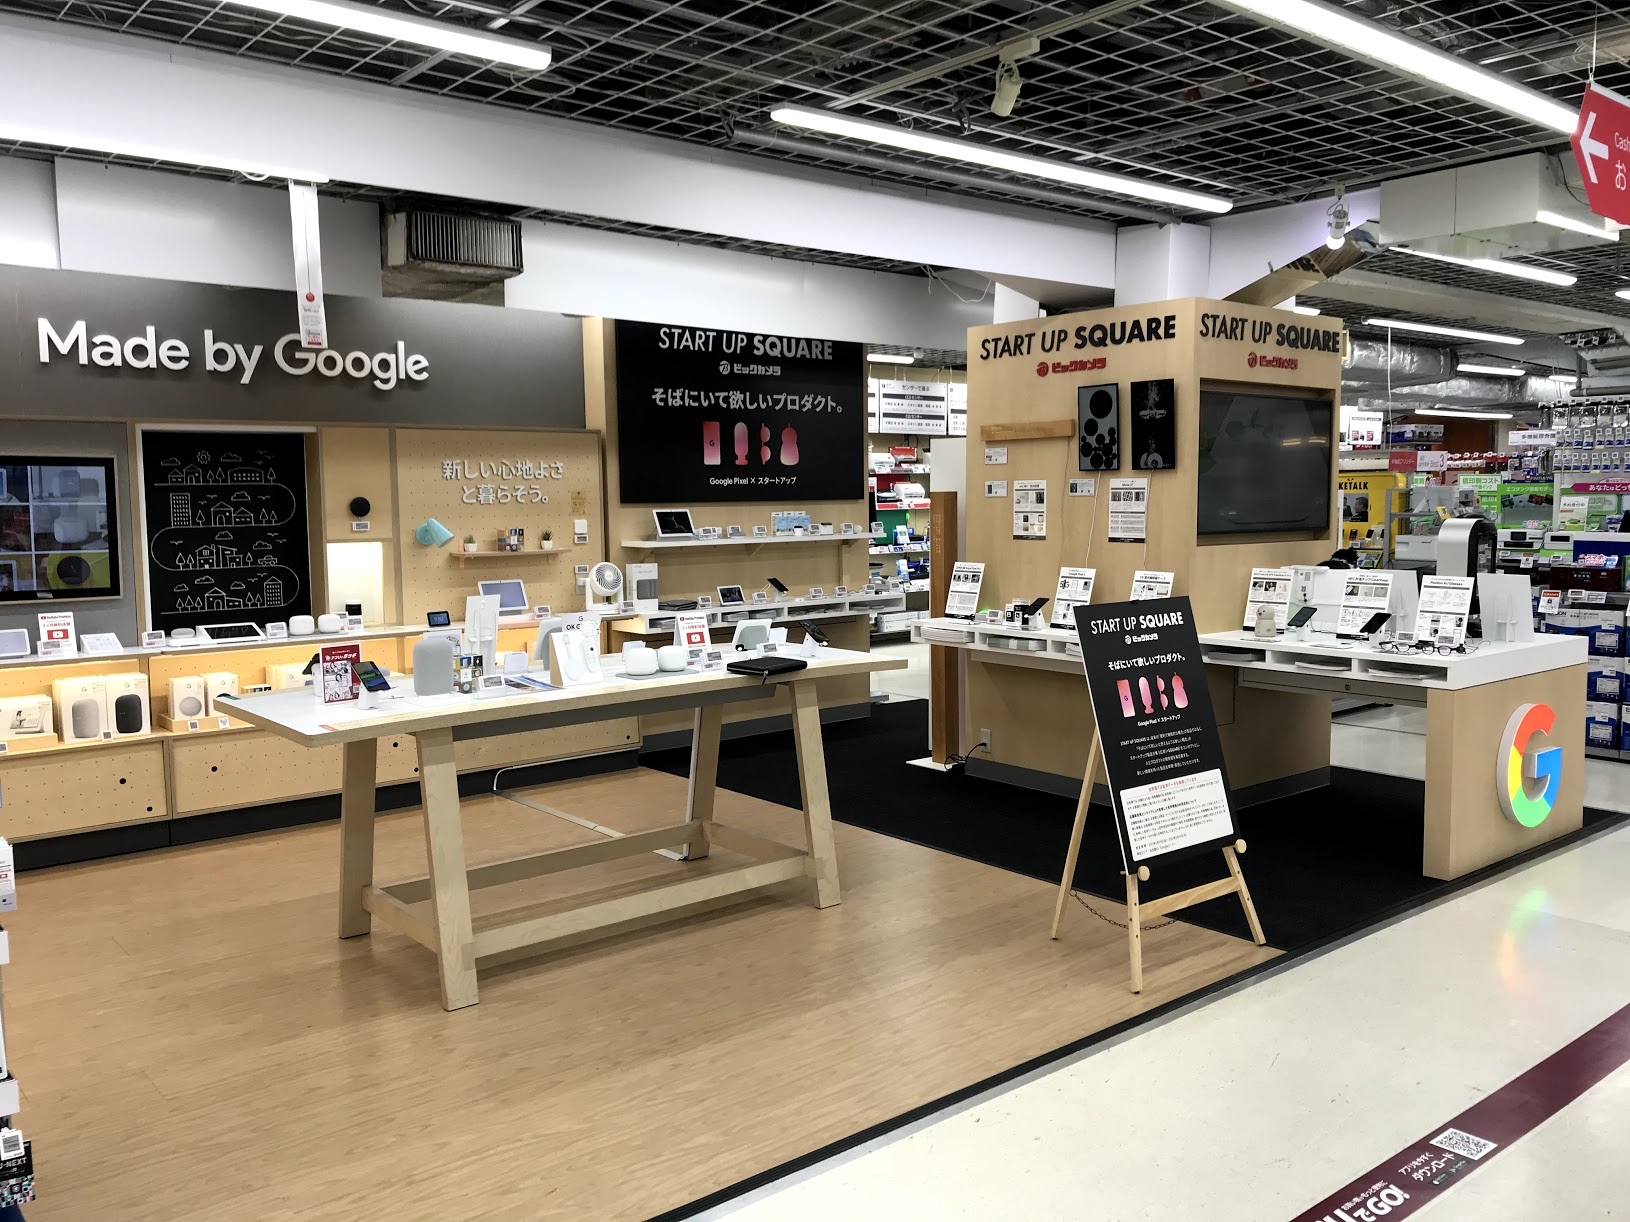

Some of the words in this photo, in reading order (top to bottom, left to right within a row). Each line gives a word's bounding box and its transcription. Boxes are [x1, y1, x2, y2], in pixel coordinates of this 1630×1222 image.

[658, 326, 717, 352] START
[722, 331, 748, 354] UP
[752, 333, 833, 361] SQUARE
[979, 332, 1036, 361] START
[1041, 328, 1068, 353] UP
[1073, 314, 1177, 350] SQUARE
[1200, 312, 1249, 342] START
[1251, 319, 1273, 344] UP
[1275, 322, 1340, 353] SQUARE
[37, 317, 191, 371] Made
[204, 328, 264, 385] by
[273, 332, 430, 391] Google
[1051, 356, 1107, 375] ビックカメラ
[1259, 355, 1299, 370] ビックカメラ
[733, 362, 782, 376] ビックカメラ
[651, 387, 843, 414] そばにいて欲しいプロダクト。
[442, 459, 564, 480] 新しい心地よさ
[709, 477, 733, 486] Google
[733, 477, 749, 485] Pixel
[757, 476, 797, 485] スタートアップ
[462, 483, 549, 505] と暮らそう。
[1090, 618, 1120, 635] START
[1123, 616, 1137, 631] UP
[1139, 611, 1184, 629] SQUARE
[1132, 632, 1159, 643] ビックカメラ
[1108, 652, 1186, 671] そばにいて欲しいプロダクト。
[1497, 703, 1562, 828] G
[1411, 1152, 1455, 1181] ダウンロード
